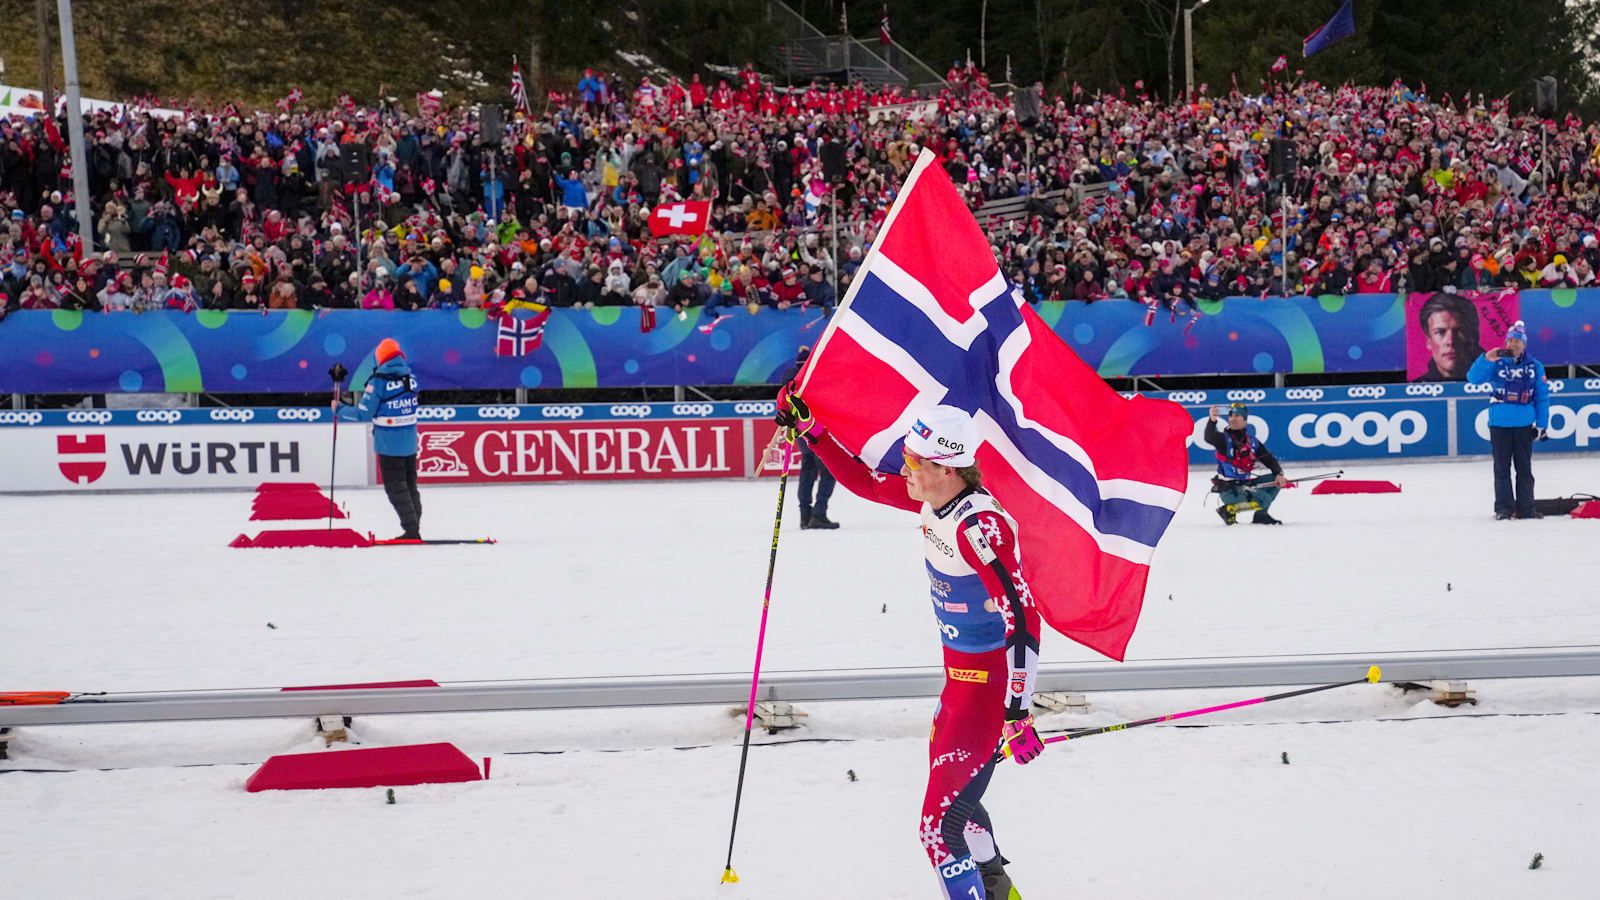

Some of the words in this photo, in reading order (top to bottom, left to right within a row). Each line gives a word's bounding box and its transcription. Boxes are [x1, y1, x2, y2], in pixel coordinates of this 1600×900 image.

[1406, 384, 1444, 397] coop
[1464, 383, 1493, 394] coo
[1584, 379, 1600, 390] co
[1168, 391, 1207, 404] coop
[1227, 390, 1265, 402] coop
[1286, 388, 1323, 401] coop
[1348, 385, 1386, 398] coop
[386, 397, 411, 409] TEAM
[673, 403, 713, 416] coop
[735, 402, 775, 415] coop
[136, 410, 182, 424] coop
[210, 408, 255, 422] coop
[277, 408, 321, 422] coop
[415, 407, 456, 420] coop
[478, 406, 520, 419] coop
[541, 405, 583, 418] coop
[610, 404, 651, 417] coop
[0, 411, 43, 426] coop
[67, 411, 113, 424] coop
[1288, 410, 1428, 453] coop
[473, 426, 731, 477] GENERALI
[952, 670, 980, 680] DHL
[931, 752, 956, 770] AFT
[942, 856, 976, 878] coop
